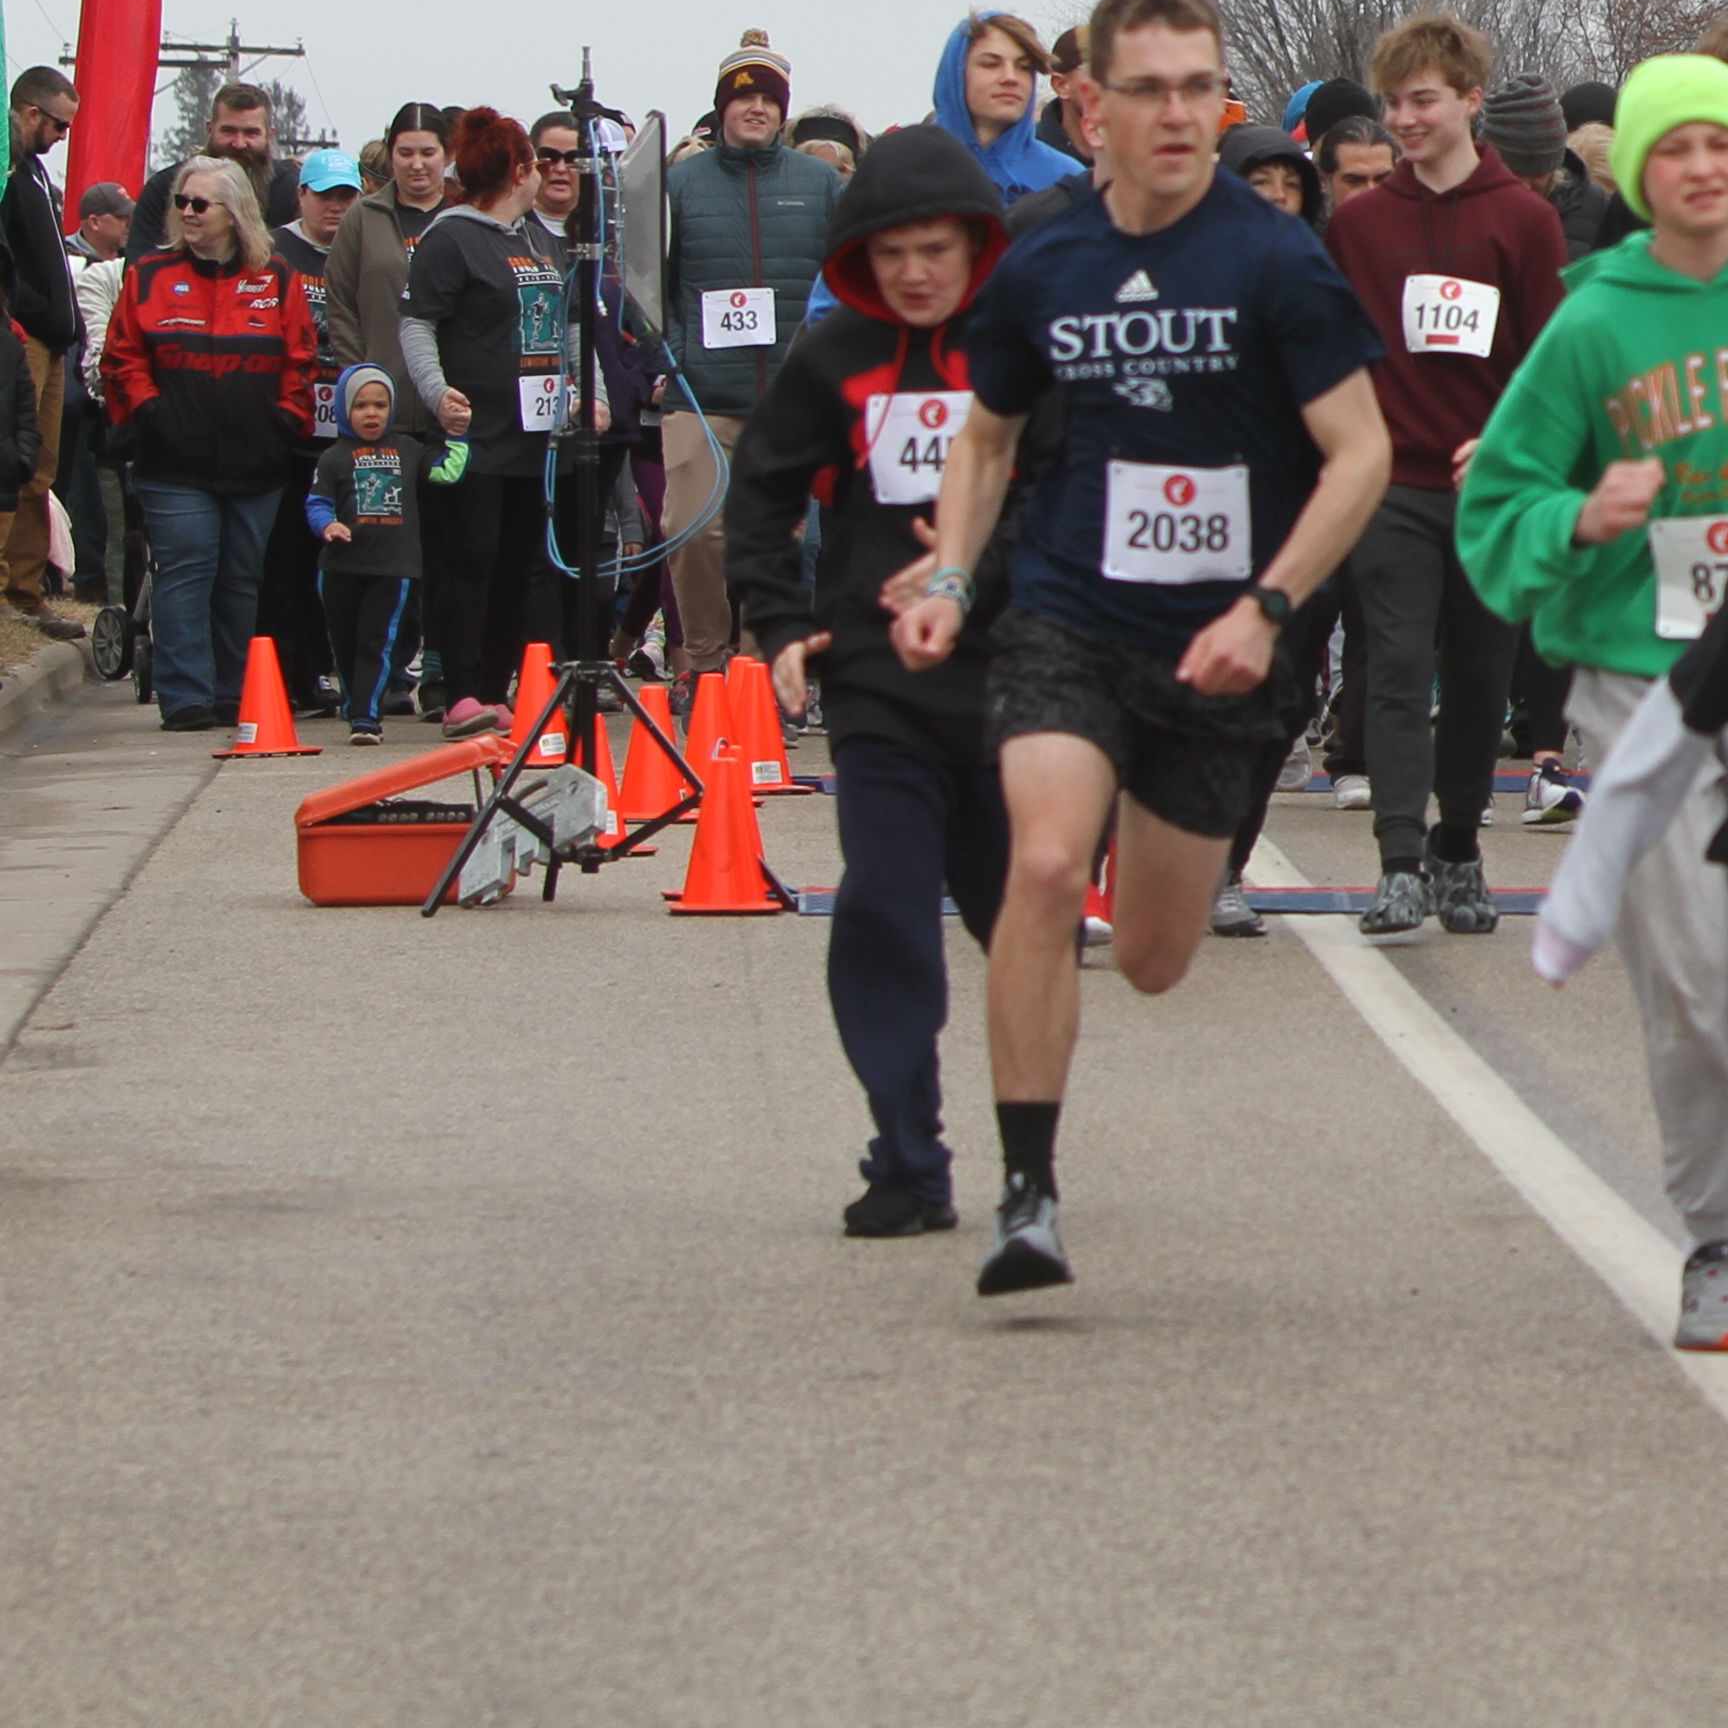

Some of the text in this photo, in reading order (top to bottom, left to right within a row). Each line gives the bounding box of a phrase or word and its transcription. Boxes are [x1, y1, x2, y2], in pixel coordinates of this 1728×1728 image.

[720, 310, 759, 333] 433
[1049, 306, 1238, 362] STOUT
[1414, 302, 1481, 334] 1104
[1122, 353, 1240, 377] COUNTRY
[315, 403, 338, 424] 08
[899, 435, 954, 474] 44
[1127, 509, 1230, 553] 2038
